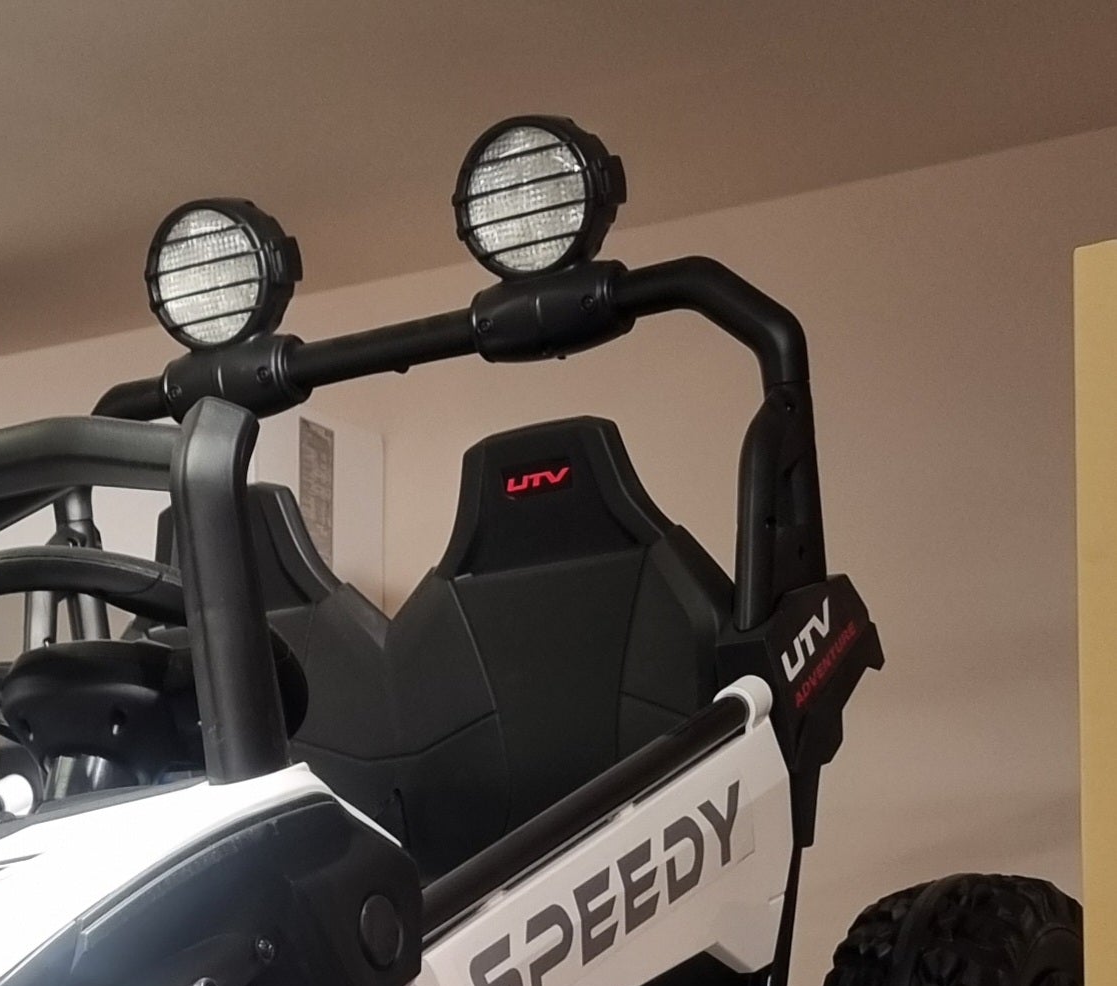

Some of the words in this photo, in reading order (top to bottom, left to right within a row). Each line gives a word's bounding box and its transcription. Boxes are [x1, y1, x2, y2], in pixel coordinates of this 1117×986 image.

[507, 467, 569, 492] UTV
[781, 596, 829, 682] UTV
[795, 620, 857, 708] ADVENTURE
